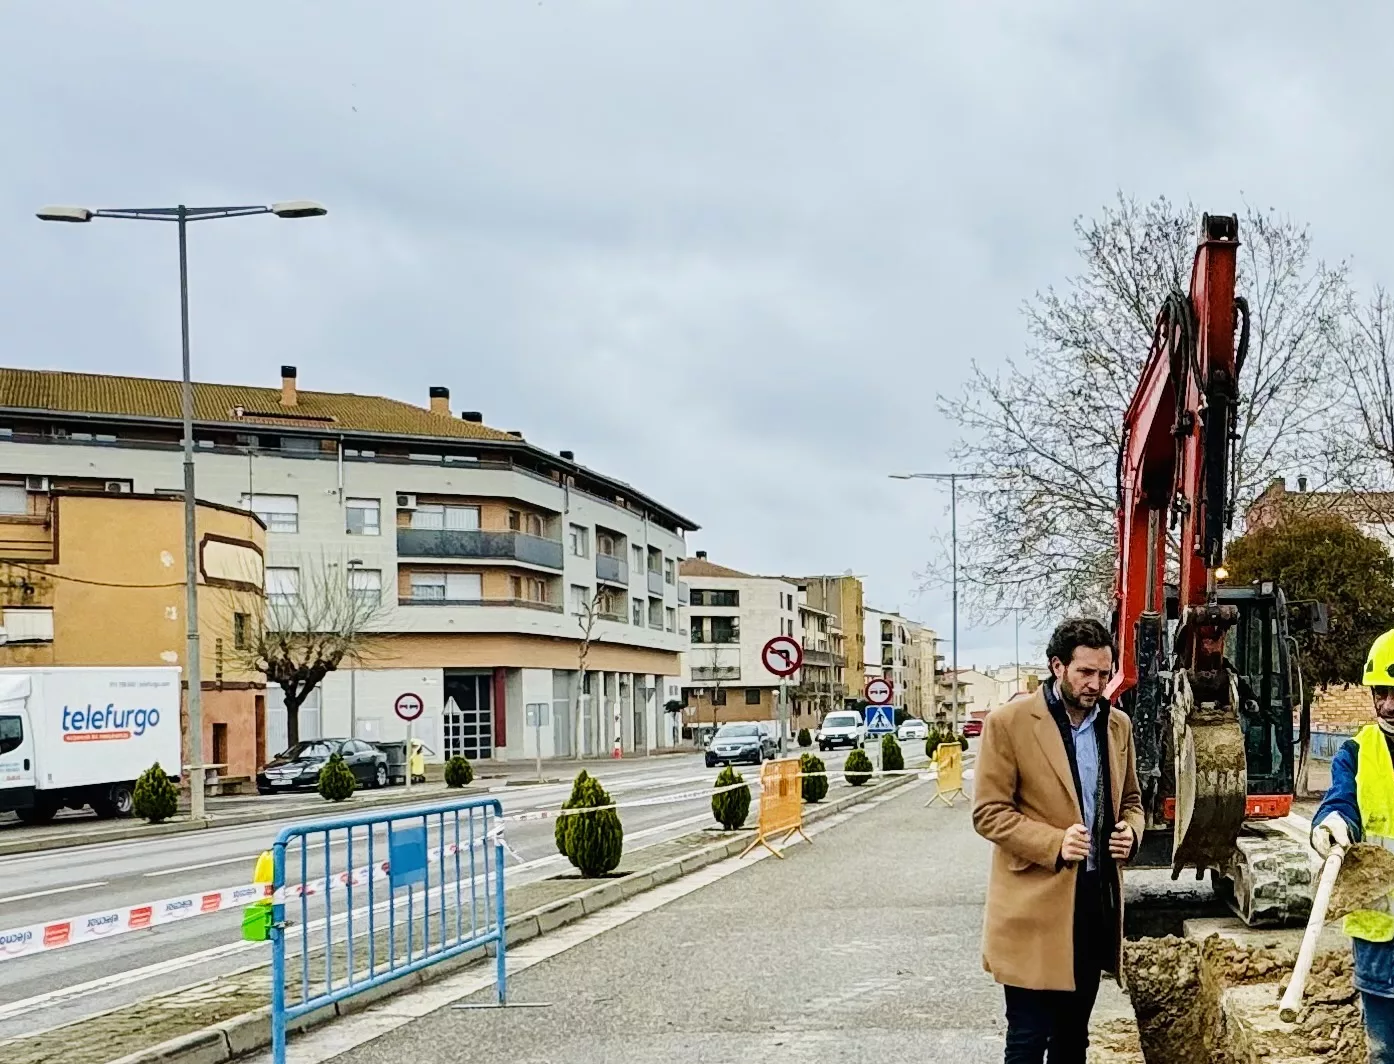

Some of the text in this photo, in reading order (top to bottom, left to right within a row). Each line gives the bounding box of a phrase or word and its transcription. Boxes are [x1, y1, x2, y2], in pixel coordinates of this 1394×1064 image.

[62, 703, 160, 736] telefurgo
[86, 913, 119, 928] elecnor
[0, 930, 33, 945] elecno
